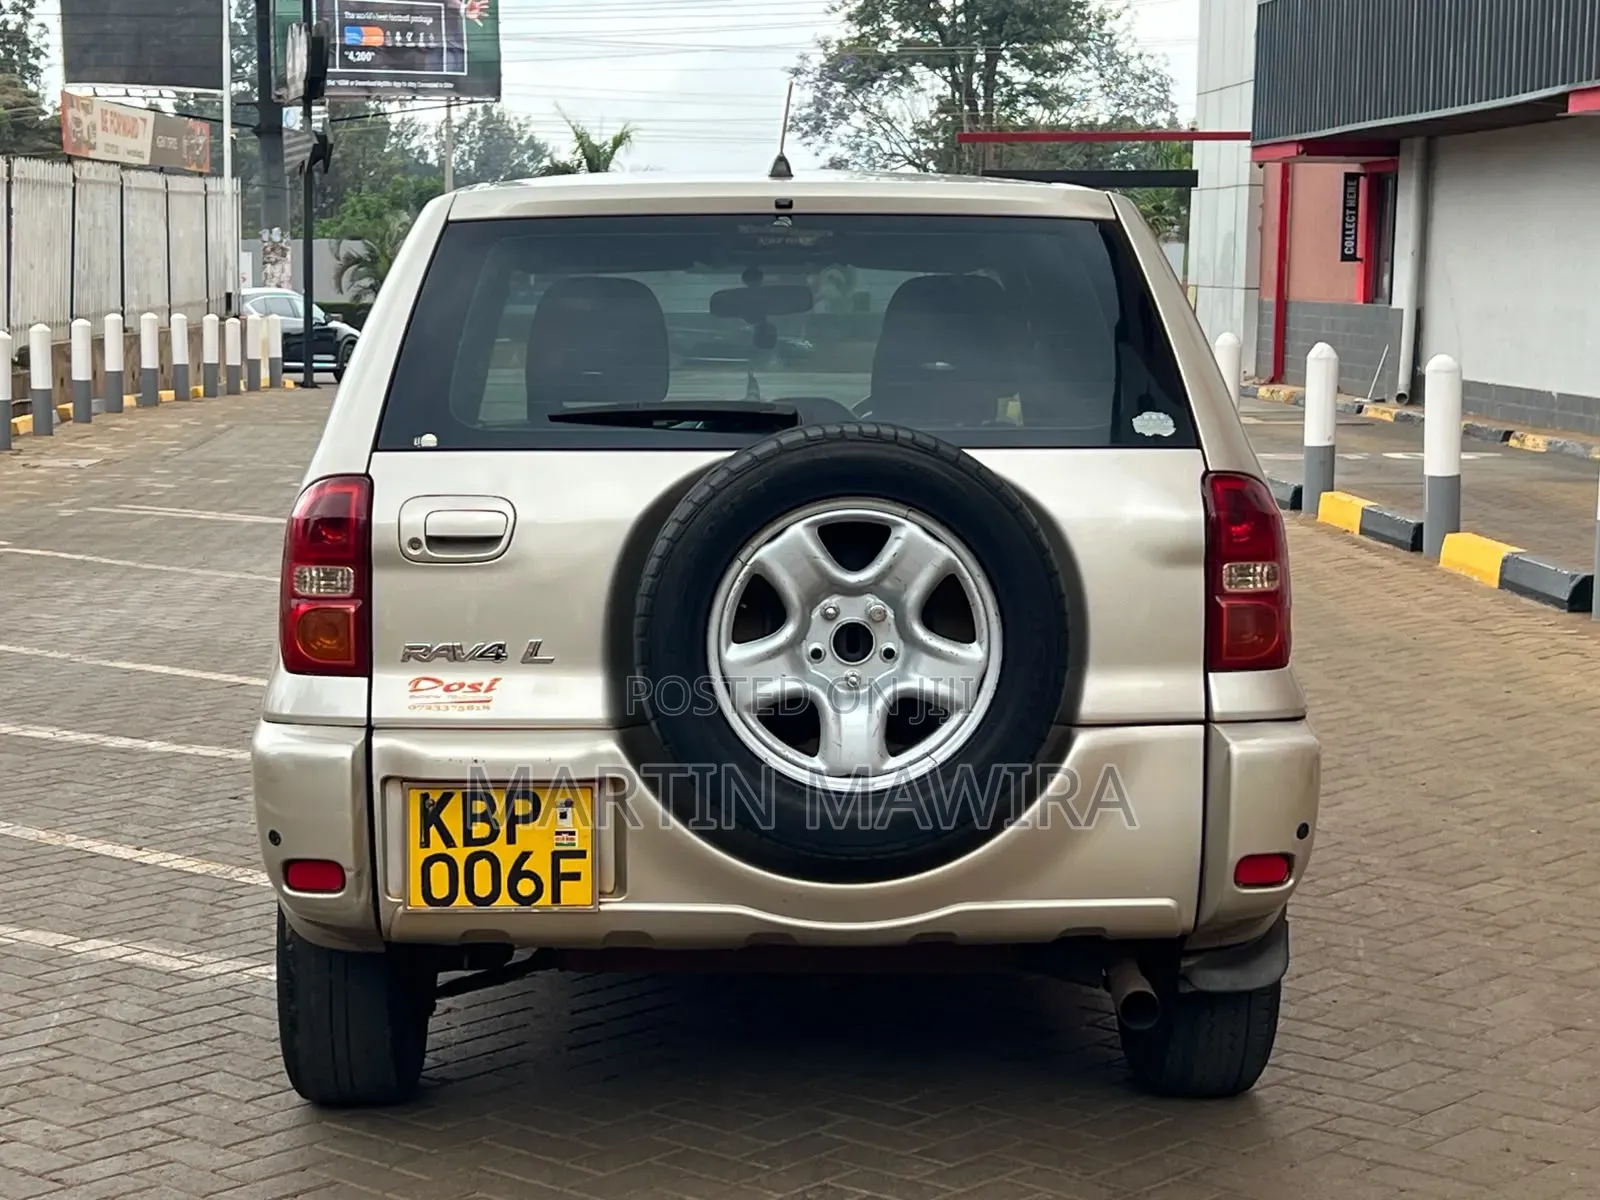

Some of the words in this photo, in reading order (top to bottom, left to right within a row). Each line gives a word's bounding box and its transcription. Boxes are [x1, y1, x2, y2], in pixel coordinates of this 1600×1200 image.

[1346, 180, 1357, 207] HERE
[1344, 209, 1356, 254] COLLECT
[401, 641, 508, 663] RAV4
[520, 639, 555, 664] L
[419, 790, 542, 849] KBP
